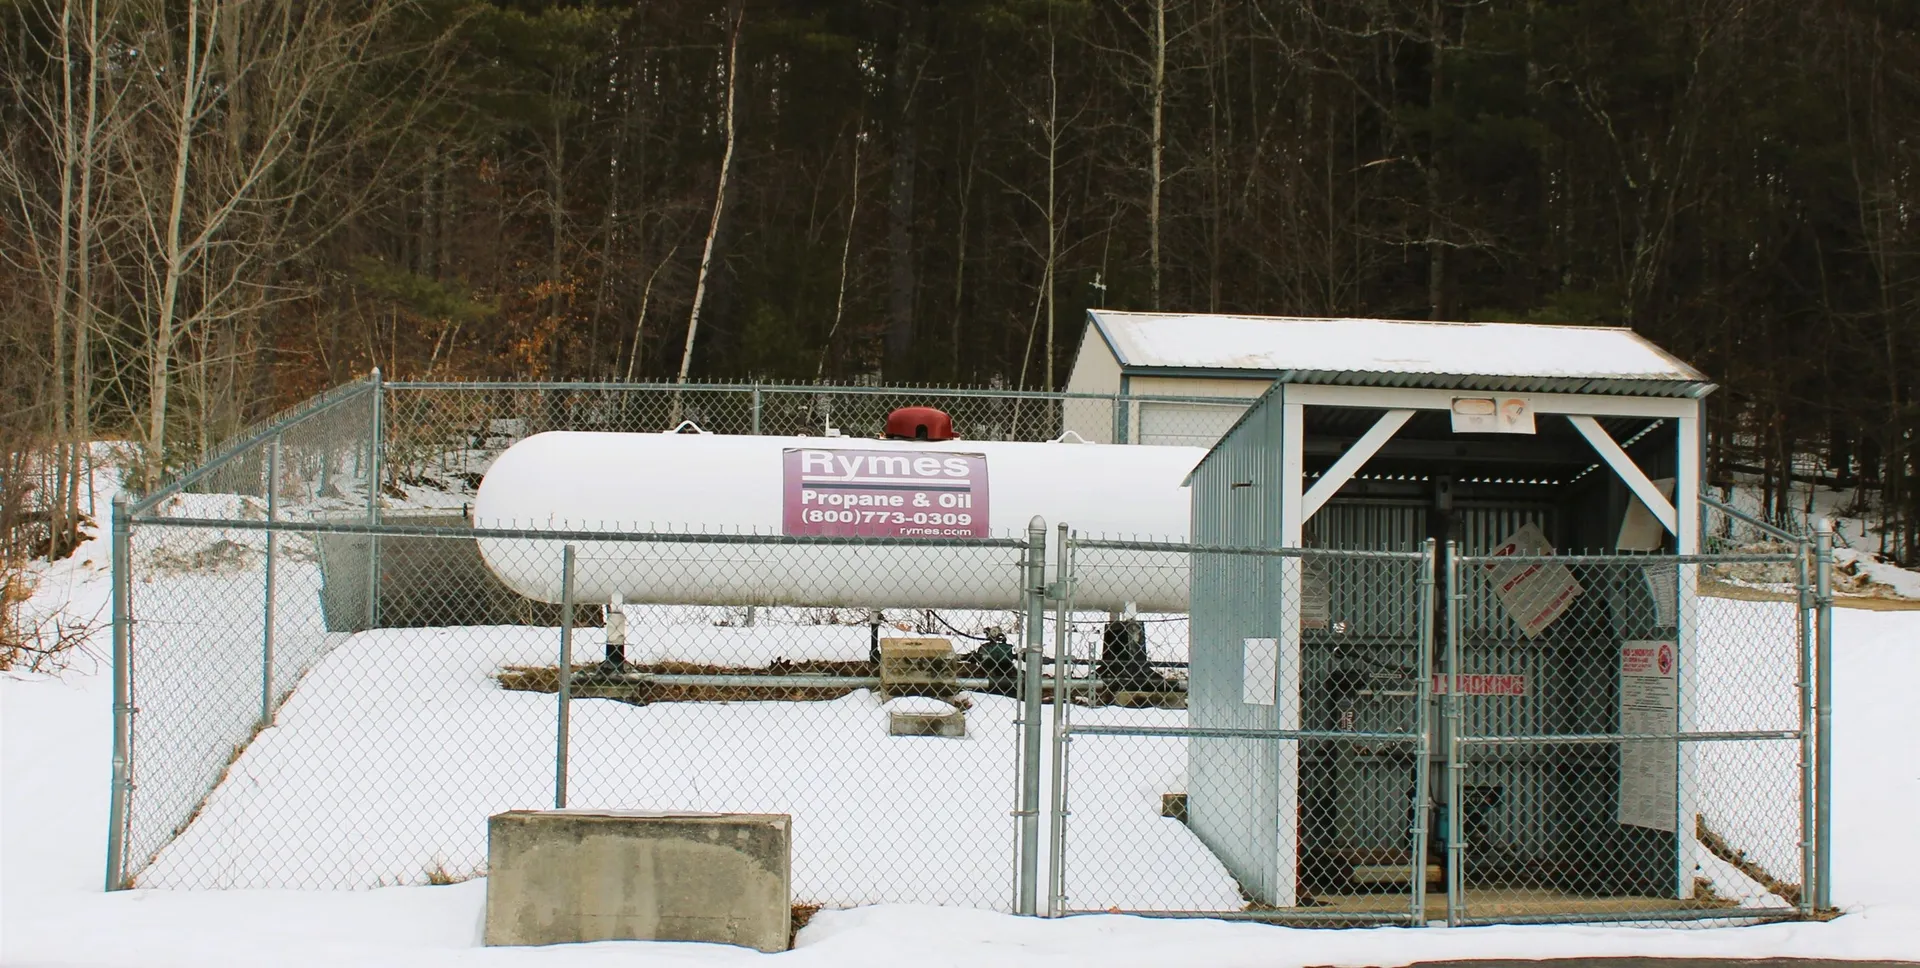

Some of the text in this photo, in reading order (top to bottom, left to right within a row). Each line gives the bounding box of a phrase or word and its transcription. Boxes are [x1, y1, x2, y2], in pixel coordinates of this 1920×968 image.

[802, 450, 970, 481] Rymes
[802, 490, 971, 508] Propane & Oil
[802, 508, 971, 525] (800)773-0309
[899, 527, 971, 536] rymes.com
